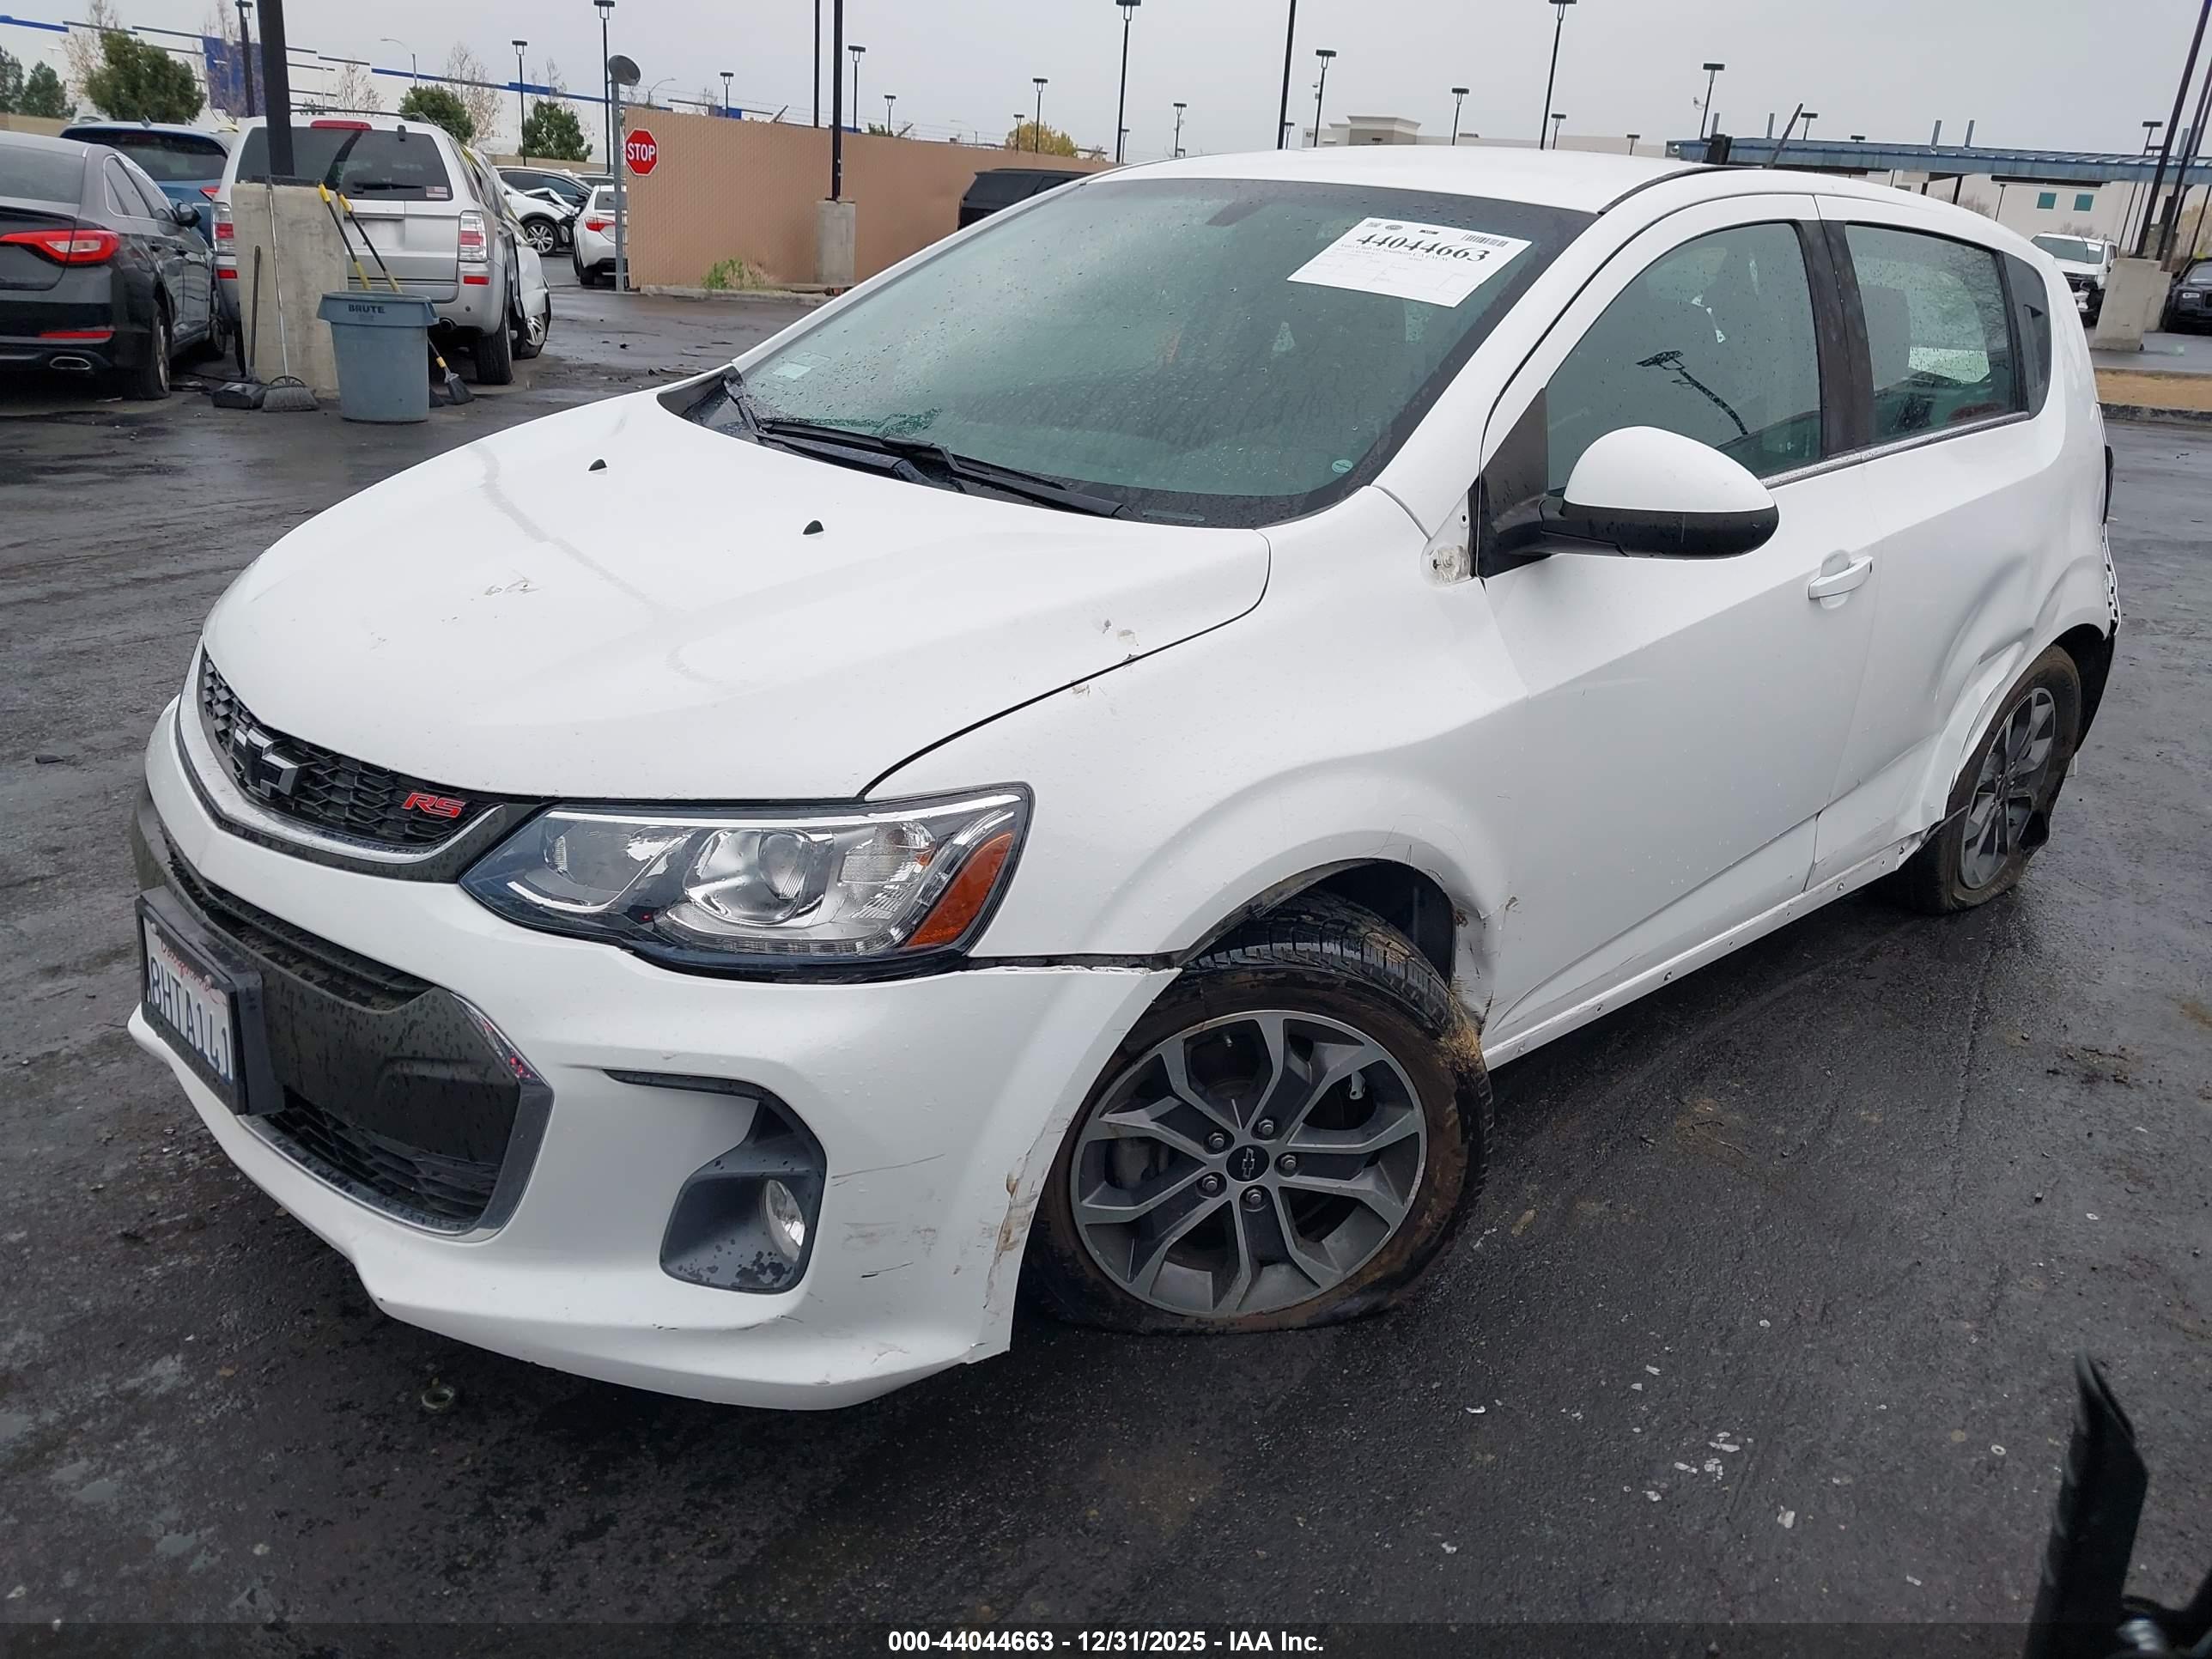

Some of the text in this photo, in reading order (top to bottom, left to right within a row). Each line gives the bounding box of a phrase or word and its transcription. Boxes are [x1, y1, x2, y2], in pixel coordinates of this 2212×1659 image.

[627, 143, 656, 161] STOP
[1357, 234, 1490, 262] 44044663
[348, 303, 386, 314] BRUTE
[401, 792, 467, 818] RS
